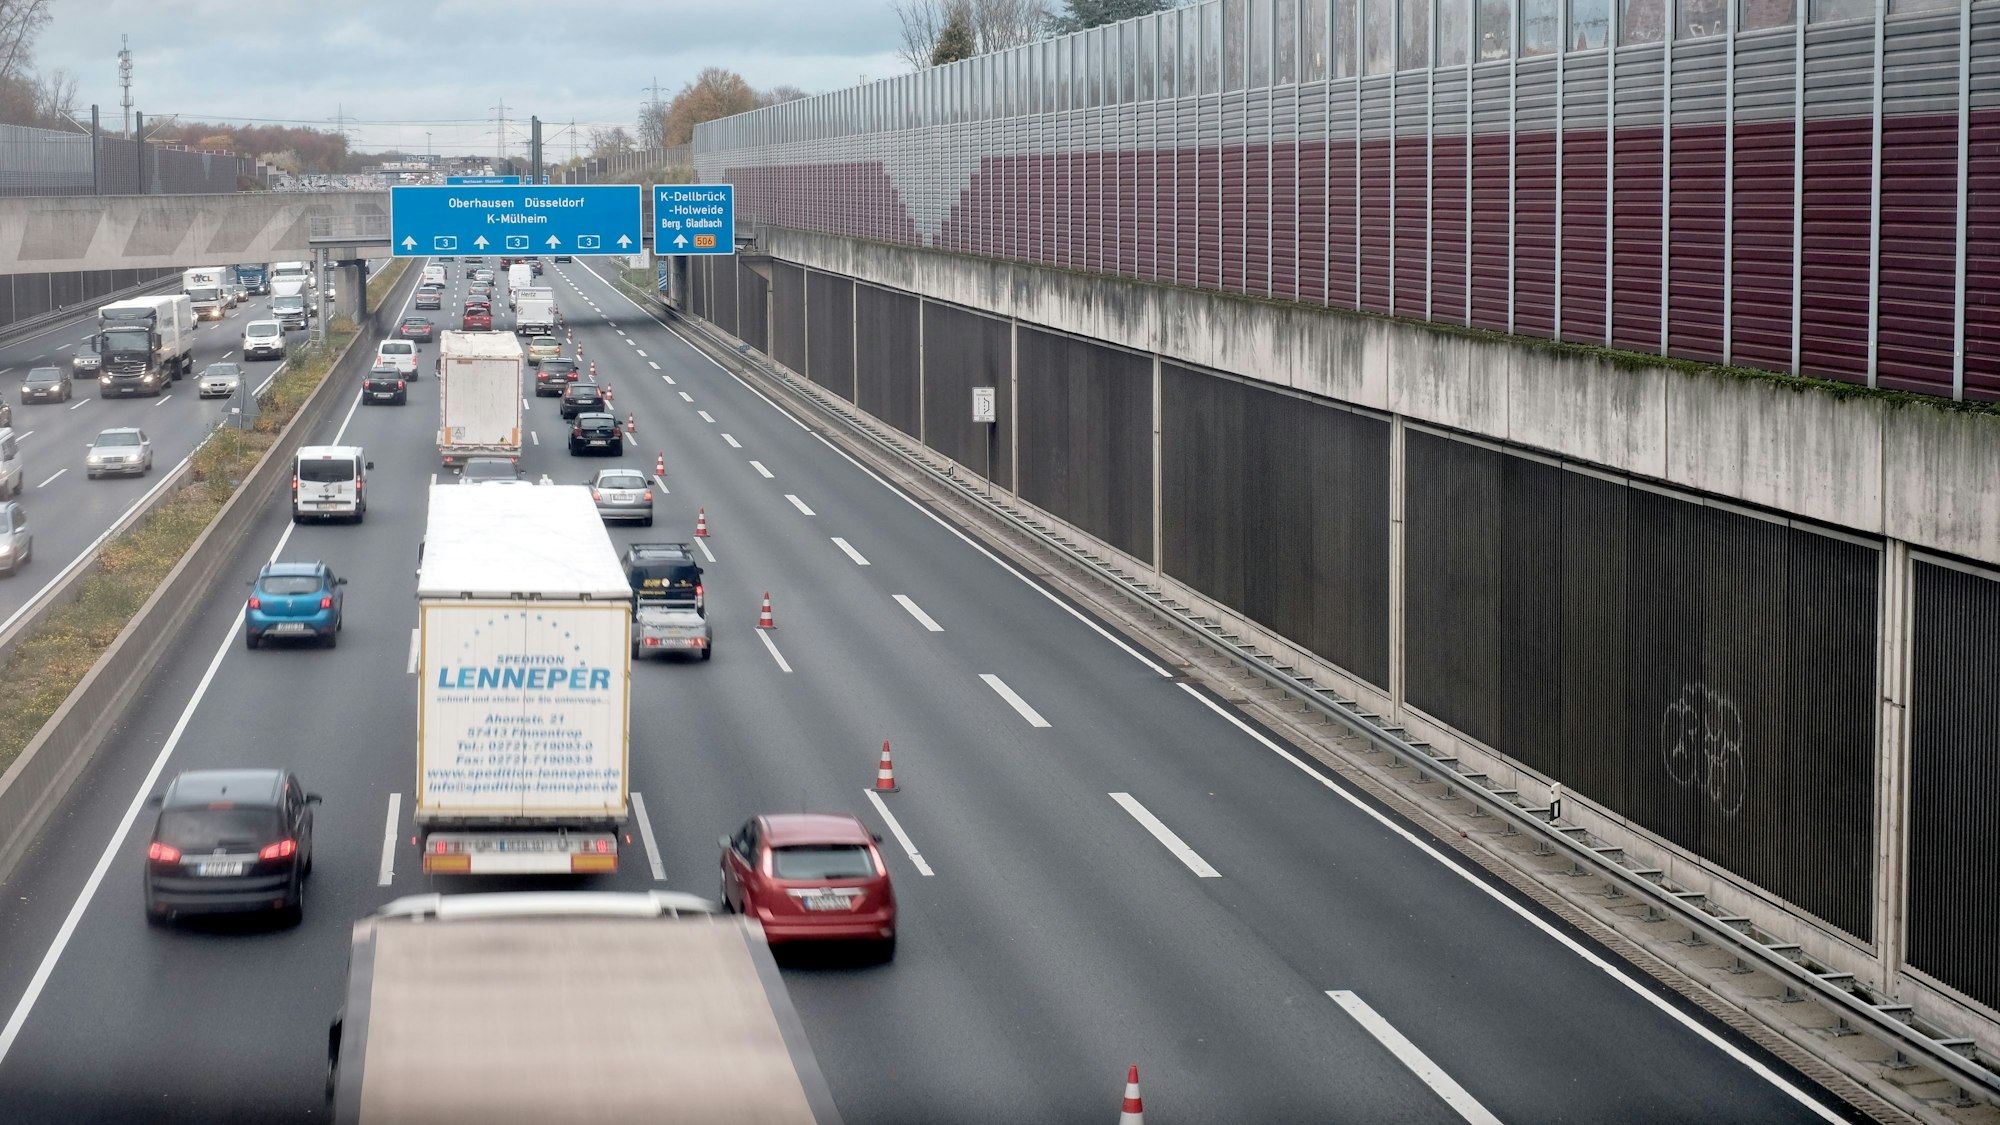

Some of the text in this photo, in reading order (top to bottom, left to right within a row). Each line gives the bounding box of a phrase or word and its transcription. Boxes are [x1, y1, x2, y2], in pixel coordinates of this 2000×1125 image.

[660, 191, 726, 202] K-Dellbrück
[448, 197, 585, 208] Oberhausen Düsseldorf
[668, 204, 724, 215] -Holweide
[486, 213, 548, 224] K-Mülheim
[661, 218, 723, 231] Berg. Gladbach
[442, 238, 449, 248] 3
[514, 238, 521, 247] 3
[586, 237, 592, 247] 3
[696, 236, 713, 246] 506
[496, 654, 565, 665] SPEDITION
[438, 667, 611, 690] LENNEPER
[472, 695, 489, 703] und
